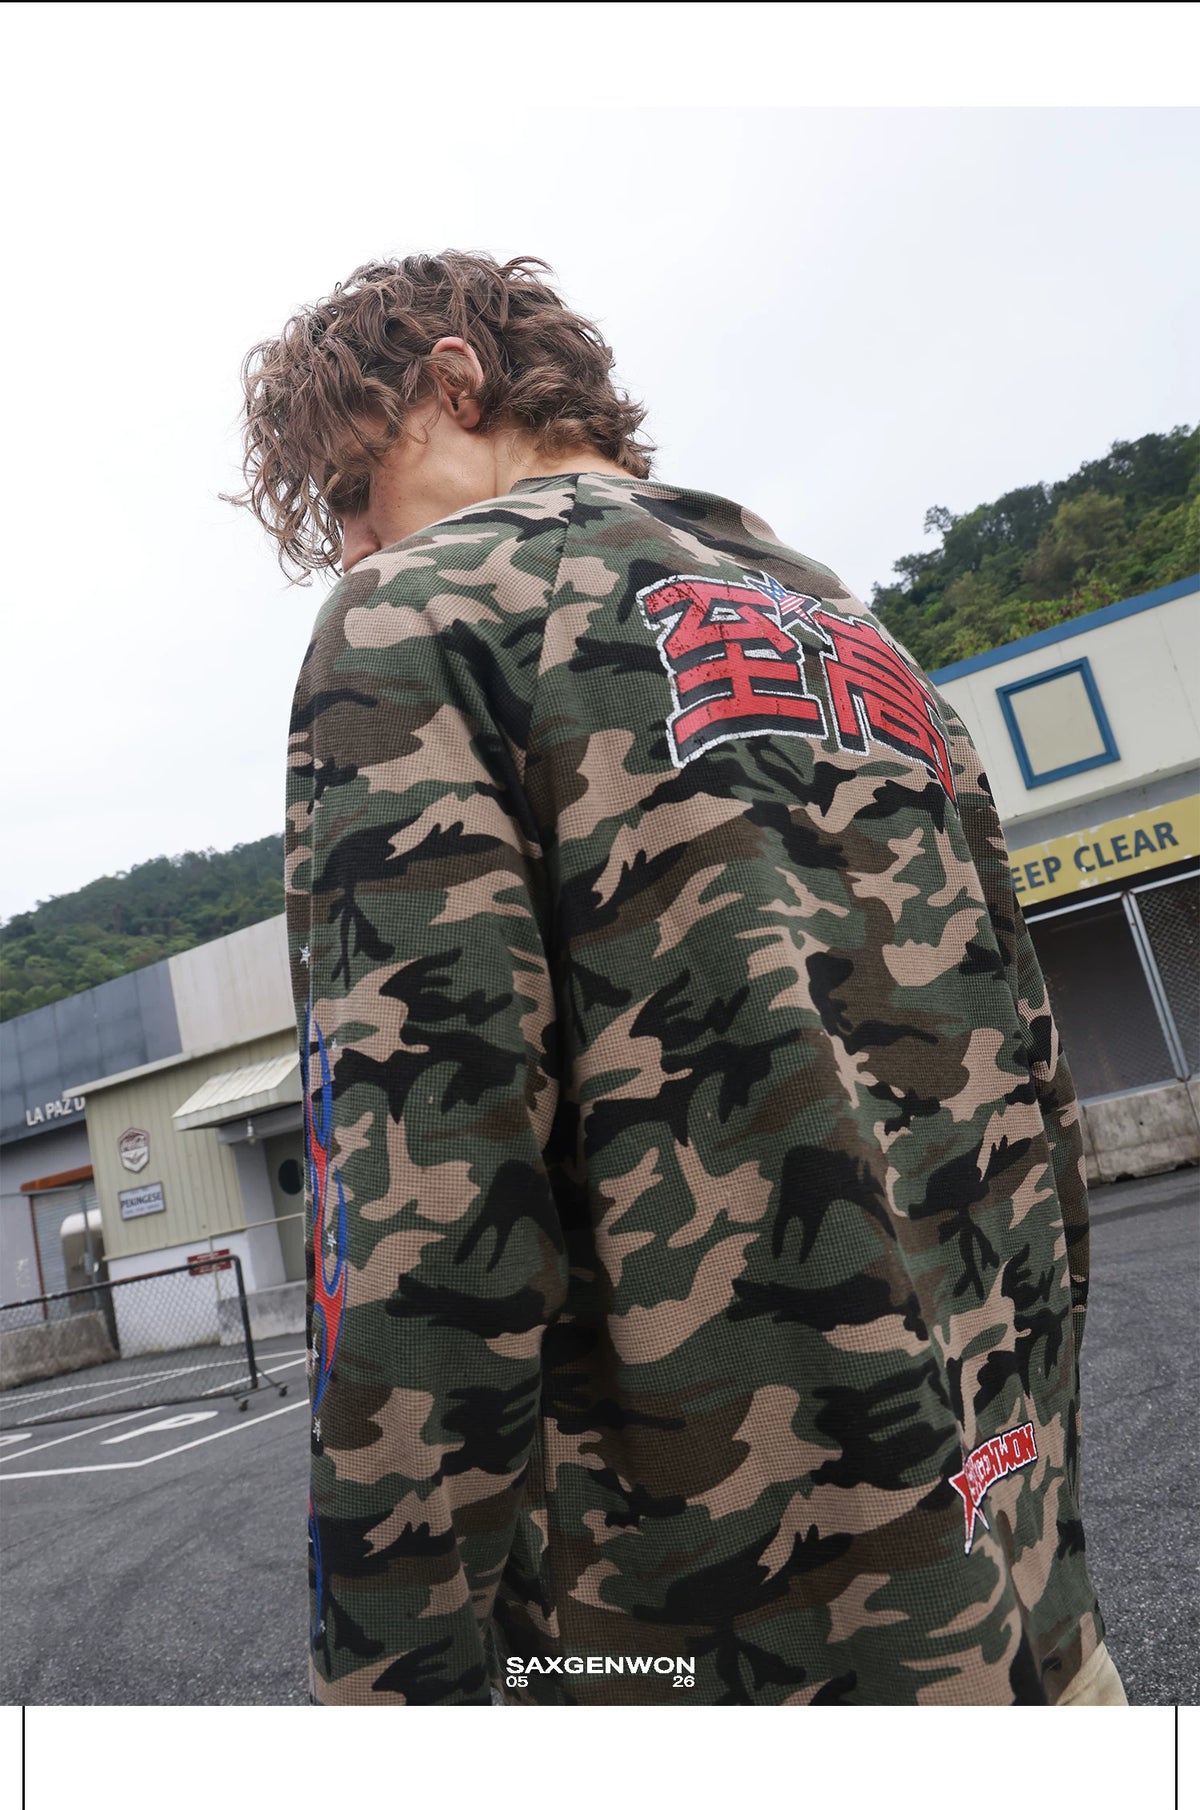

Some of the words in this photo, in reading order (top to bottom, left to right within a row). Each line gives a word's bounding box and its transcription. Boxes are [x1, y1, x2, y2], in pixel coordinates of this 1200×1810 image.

[1074, 821, 1179, 873] CLEAR
[26, 1107, 45, 1126] LA
[45, 1098, 73, 1120] PAZ
[120, 1191, 162, 1208] PEKINGESE
